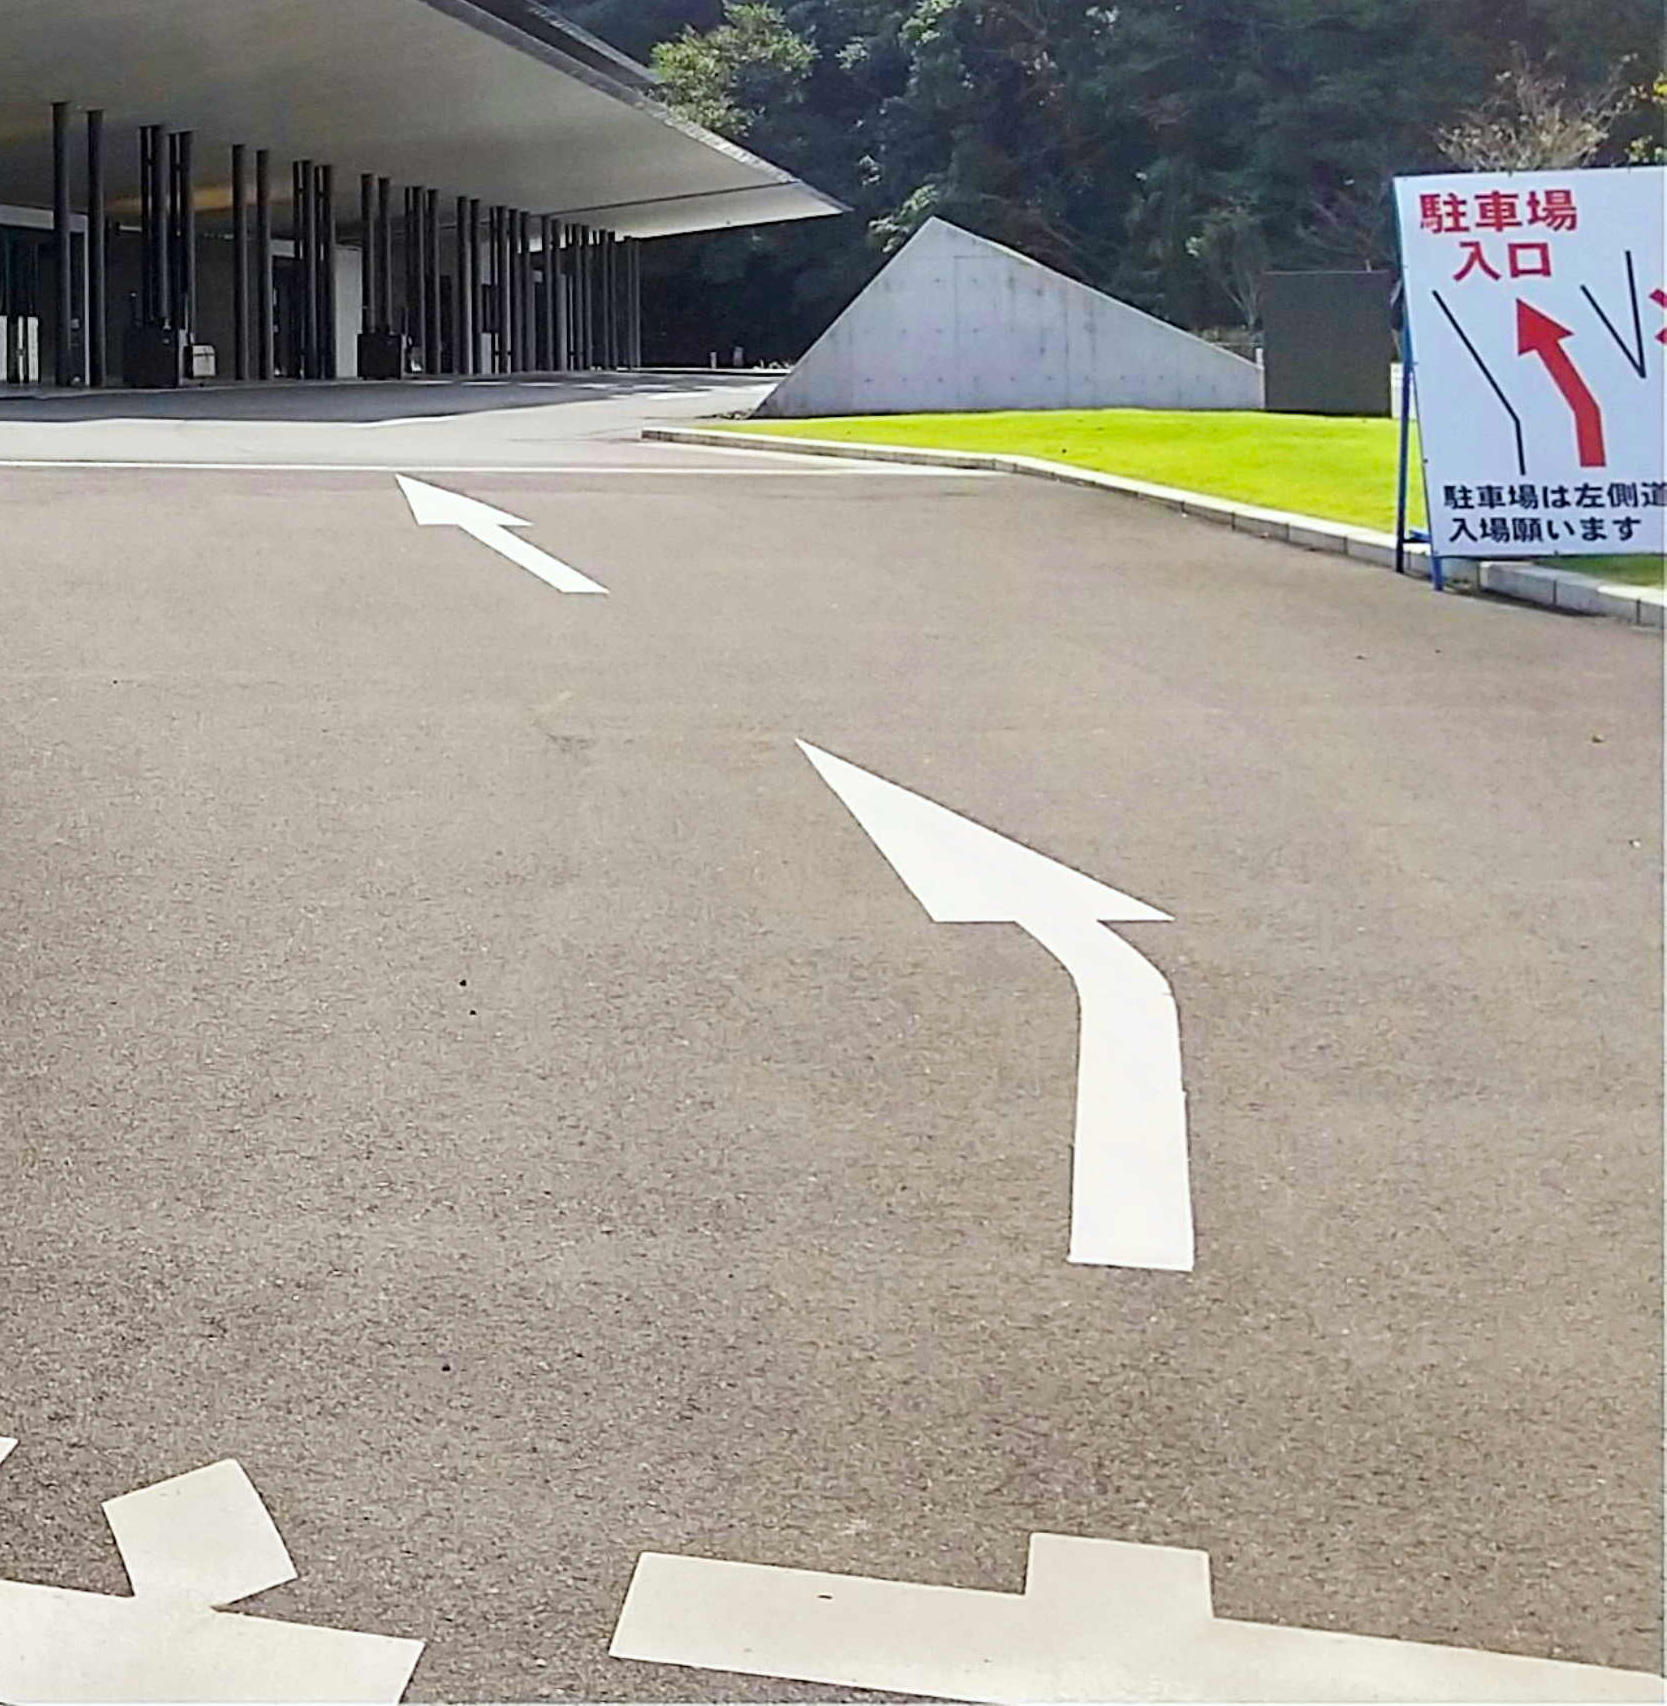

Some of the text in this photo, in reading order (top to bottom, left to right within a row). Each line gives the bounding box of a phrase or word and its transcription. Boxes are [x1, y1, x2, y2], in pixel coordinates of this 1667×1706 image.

[1419, 190, 1578, 234] 駐車場
[1453, 241, 1552, 282] 入口
[1443, 481, 1667, 510] 駐車場は左側道
[1449, 515, 1642, 544] 入場願います
